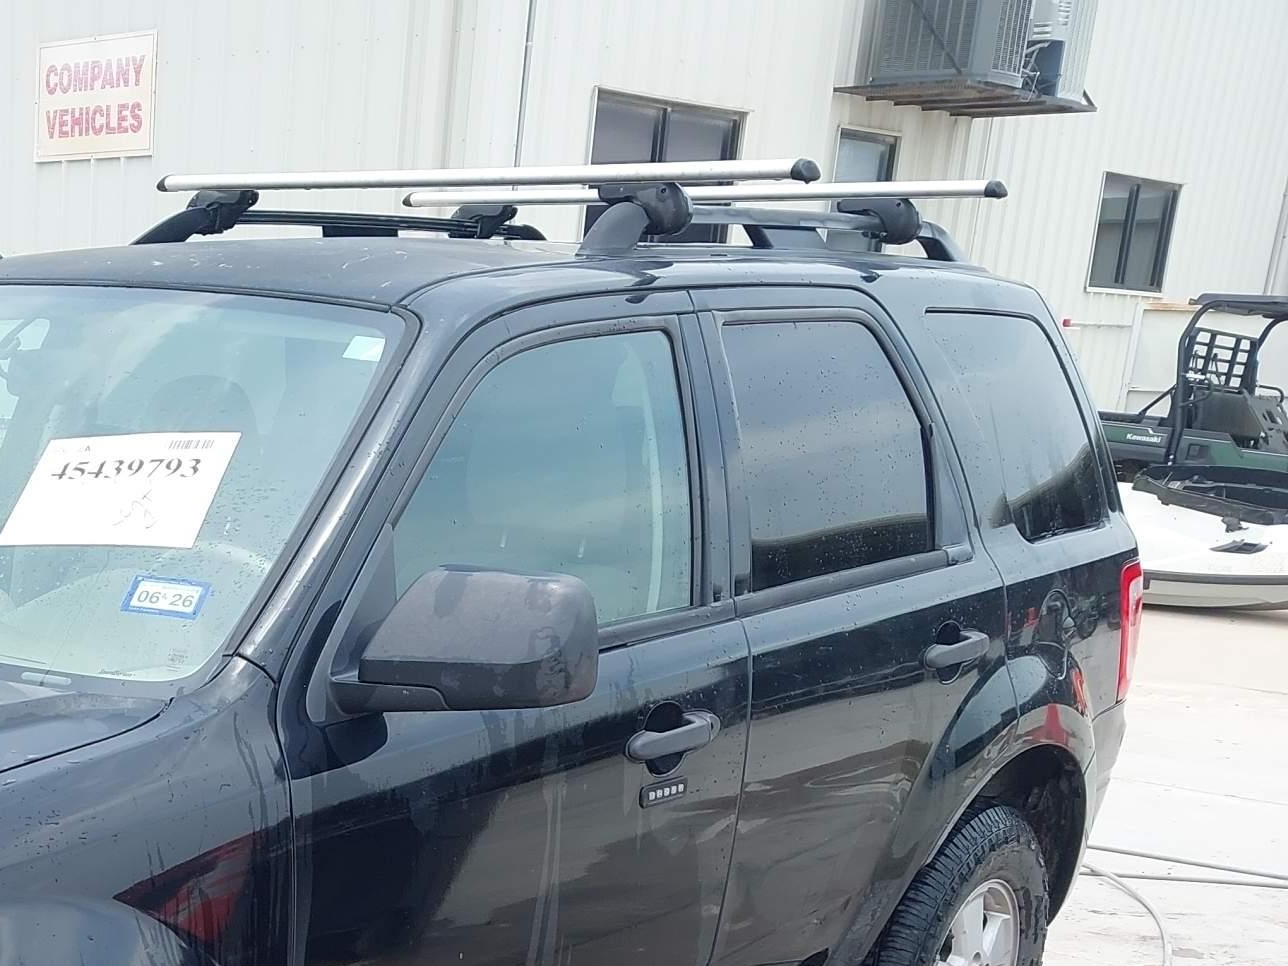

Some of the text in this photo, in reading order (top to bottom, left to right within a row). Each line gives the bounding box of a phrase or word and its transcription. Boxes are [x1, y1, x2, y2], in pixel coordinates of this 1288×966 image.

[45, 54, 146, 96] COMPANY
[45, 101, 143, 140] VEHICLES
[50, 458, 202, 481] 45439793
[137, 590, 195, 608] 06 26
